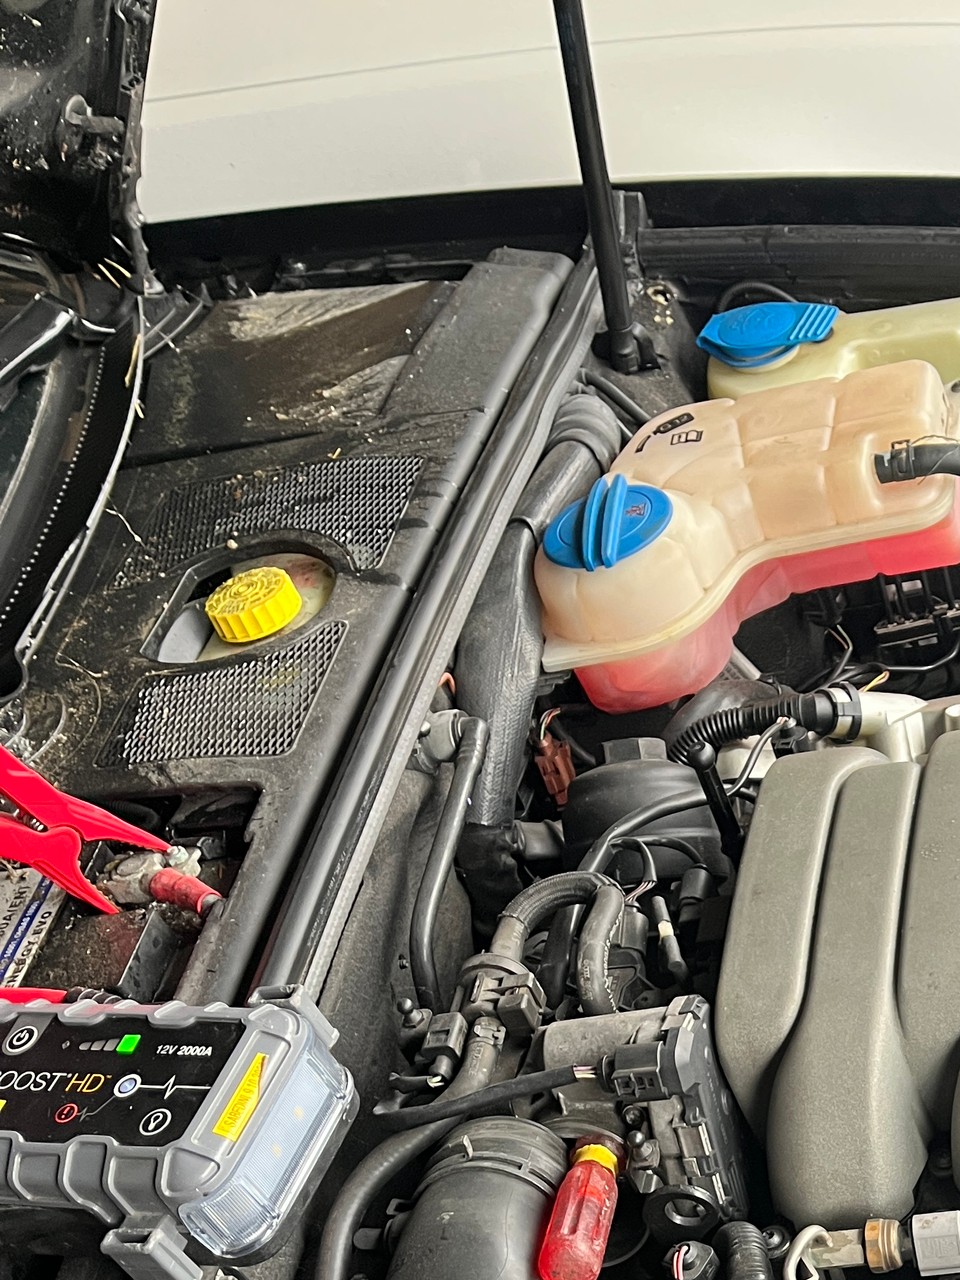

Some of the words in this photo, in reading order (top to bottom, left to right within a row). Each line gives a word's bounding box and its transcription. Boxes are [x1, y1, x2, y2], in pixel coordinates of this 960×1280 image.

[32, 911, 52, 936] EVO
[156, 1044, 179, 1055] 12V
[176, 1045, 213, 1057] 2000A
[0, 1070, 67, 1092] OOST
